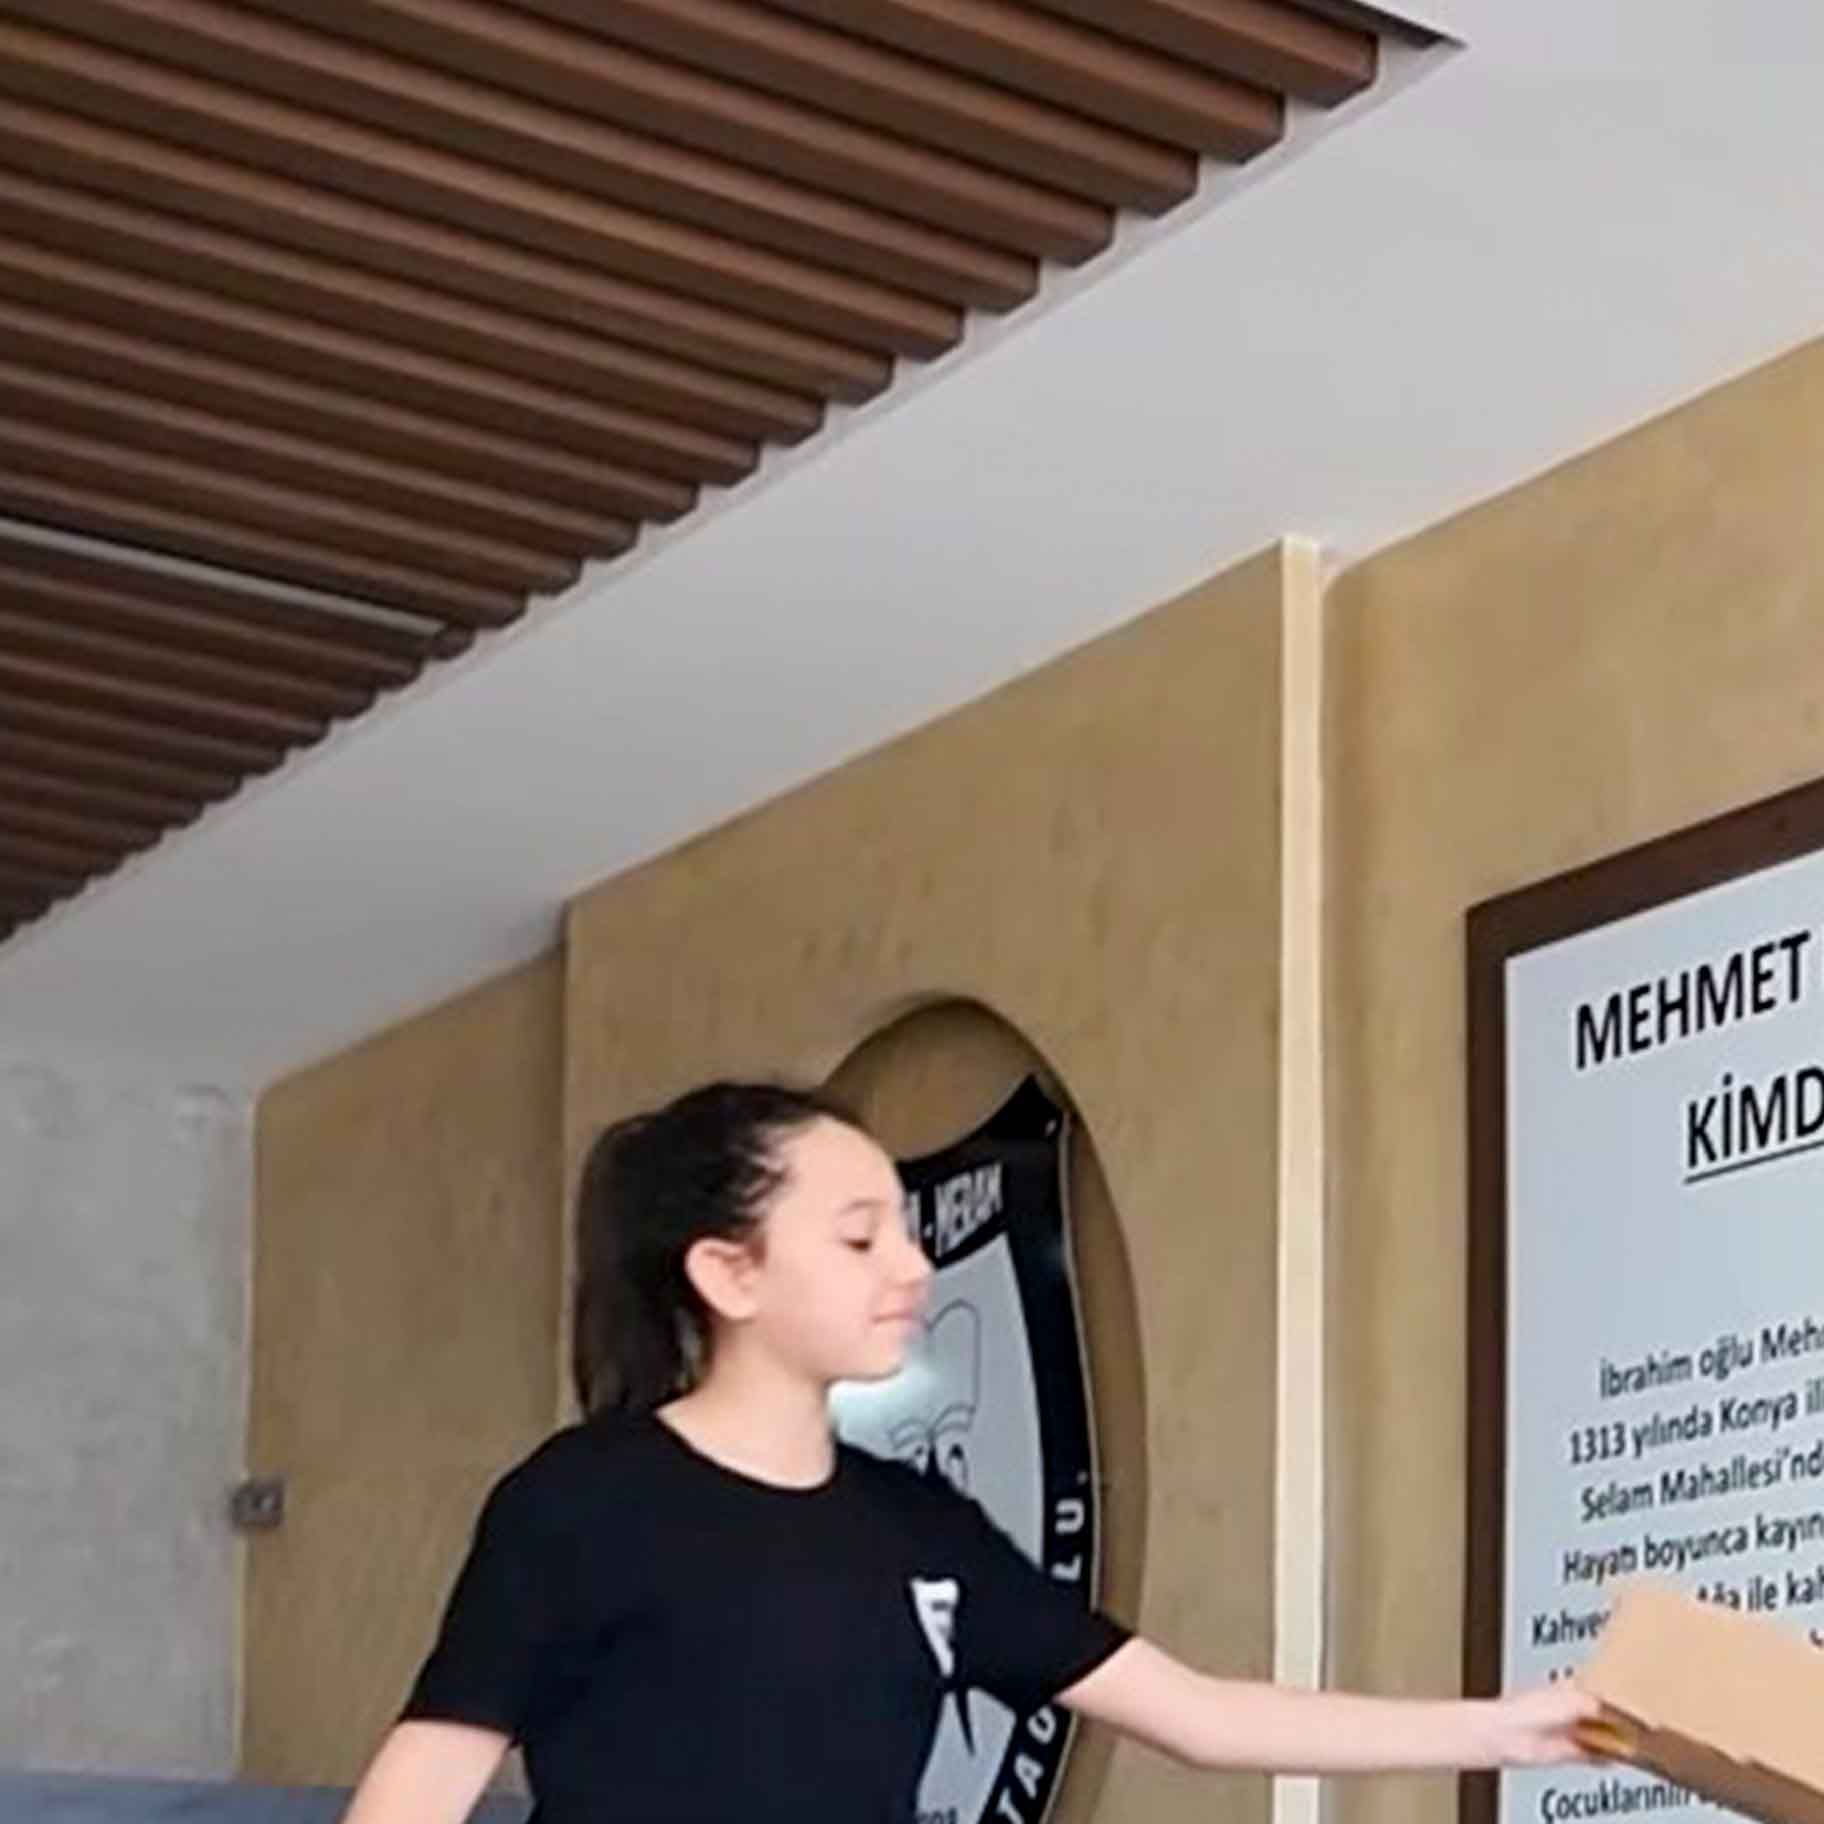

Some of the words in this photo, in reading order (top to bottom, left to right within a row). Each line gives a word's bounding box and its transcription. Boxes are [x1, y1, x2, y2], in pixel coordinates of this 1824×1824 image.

[1575, 931, 1811, 1069] MEHMET
[1699, 1335, 1753, 1381] oğlu
[1570, 1421, 1626, 1464] 1313
[1632, 1404, 1713, 1459] yılında
[1719, 1391, 1798, 1431] Konya
[1580, 1482, 1654, 1523] Selam
[1643, 1524, 1748, 1571] boyunca
[1747, 1574, 1778, 1612] ile
